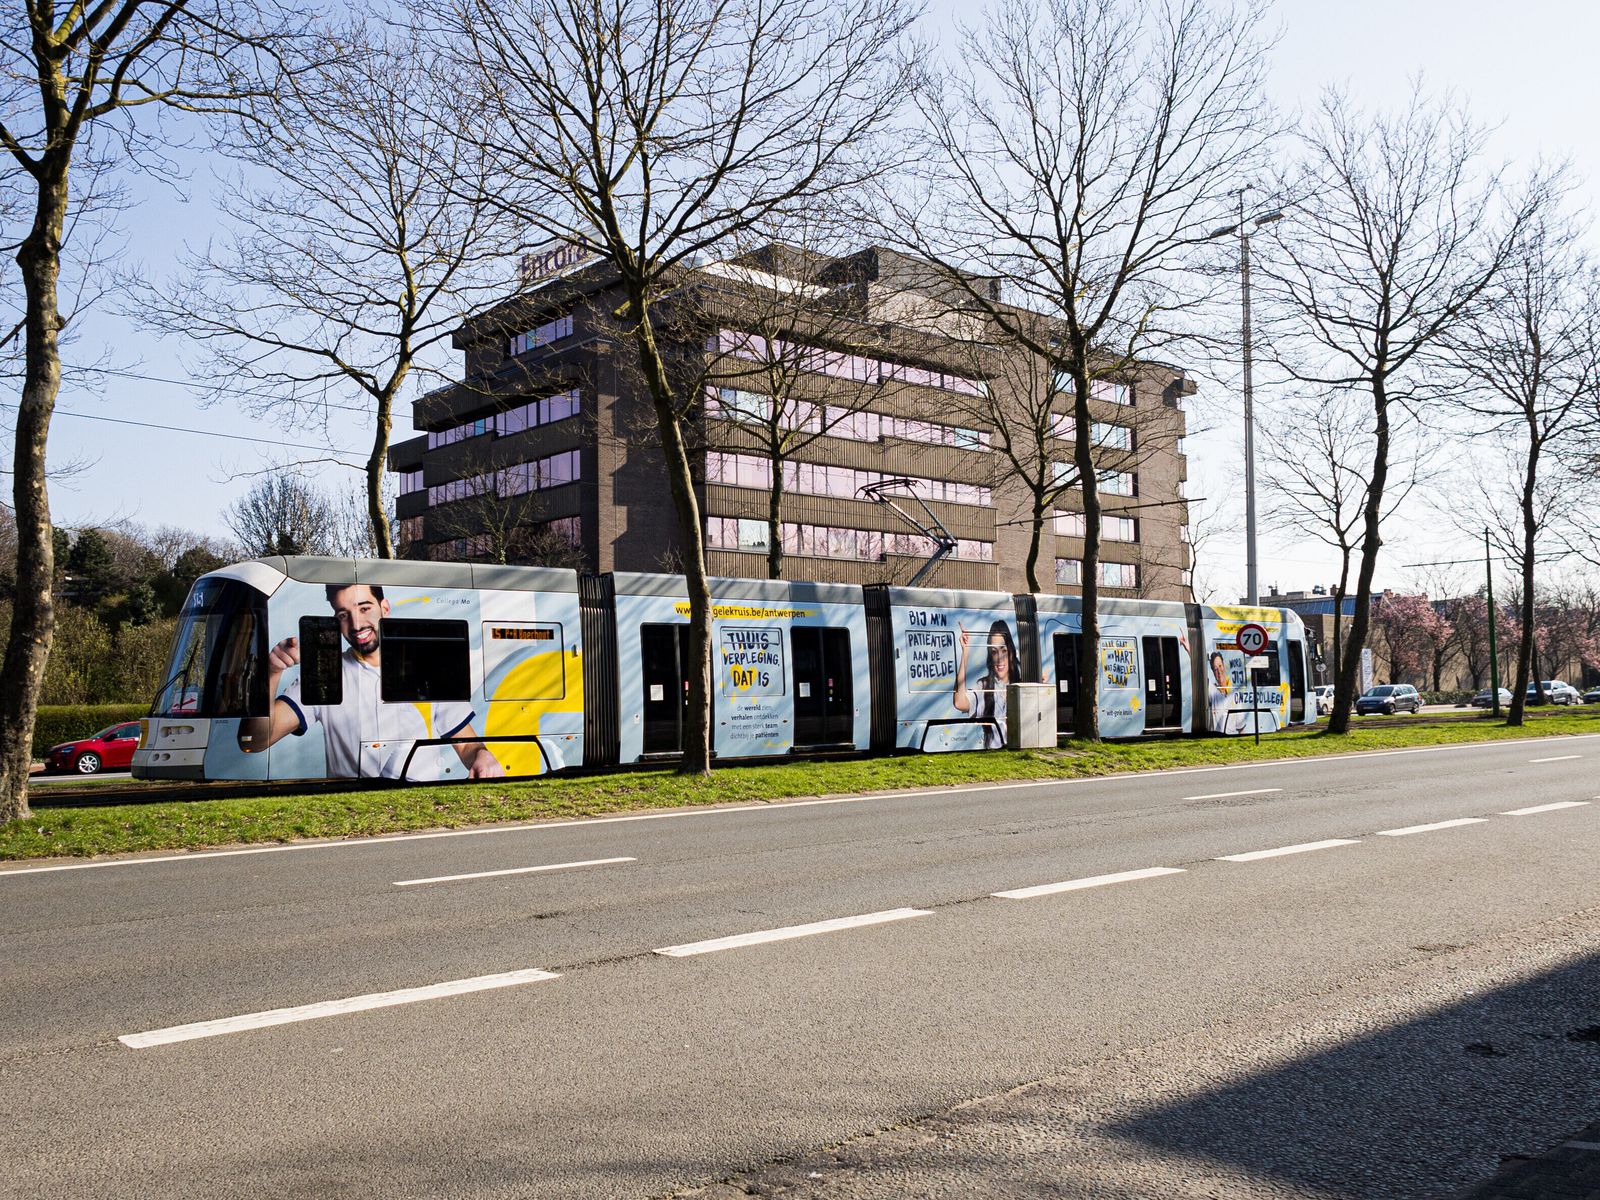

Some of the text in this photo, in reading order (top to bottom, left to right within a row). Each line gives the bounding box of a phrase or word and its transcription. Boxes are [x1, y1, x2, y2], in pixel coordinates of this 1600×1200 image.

[909, 610, 927, 626] BIJ
[727, 631, 769, 650] THUIS
[1243, 633, 1262, 646] 70
[913, 650, 941, 661] AAN DE
[1114, 650, 1133, 665] HART
[910, 661, 954, 678] SCHELDE
[1113, 664, 1136, 675] SNELLER
[733, 670, 770, 687] DAT IS
[1107, 674, 1128, 687] SLAAN
[1234, 692, 1253, 705] ONZE
